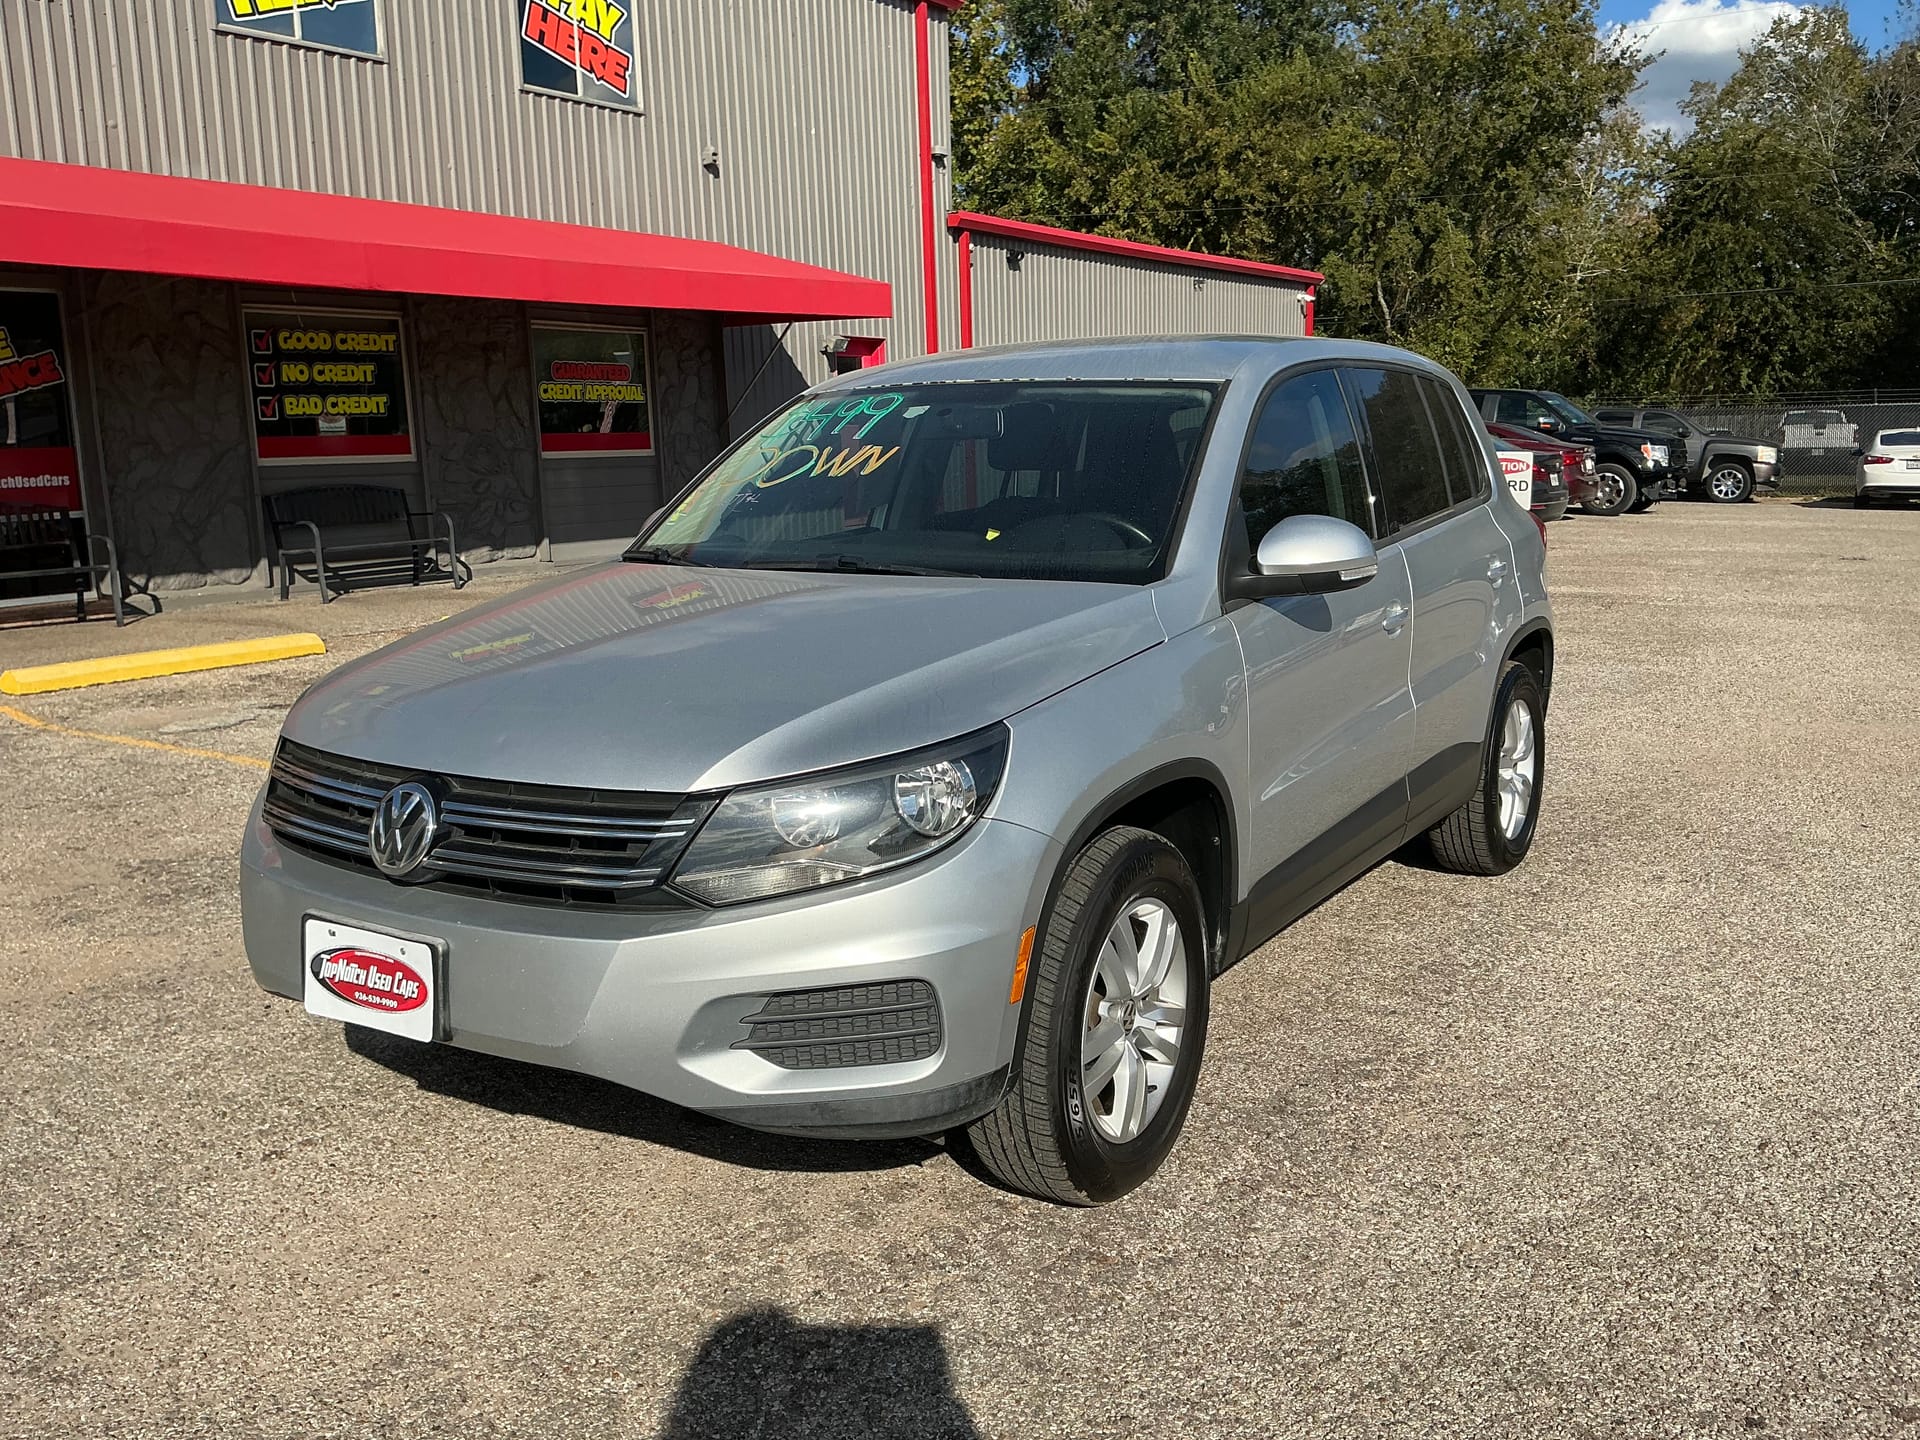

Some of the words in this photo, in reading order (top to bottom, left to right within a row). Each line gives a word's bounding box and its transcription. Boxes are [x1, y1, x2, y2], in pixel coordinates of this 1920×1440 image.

[546, 0, 625, 41] AY
[525, 2, 630, 95] HERE
[278, 330, 333, 351] GOOD
[335, 332, 397, 352] CREDIT
[0, 353, 61, 396] NCE
[281, 363, 311, 383] NO
[312, 363, 375, 383] CREDIT
[552, 361, 630, 381] GUARANTEED
[539, 382, 583, 401] CREDIT
[584, 383, 645, 402] APPROVAL
[284, 396, 324, 415] BAD
[326, 396, 388, 415] CREDIT
[0, 474, 71, 490] chUsedCars
